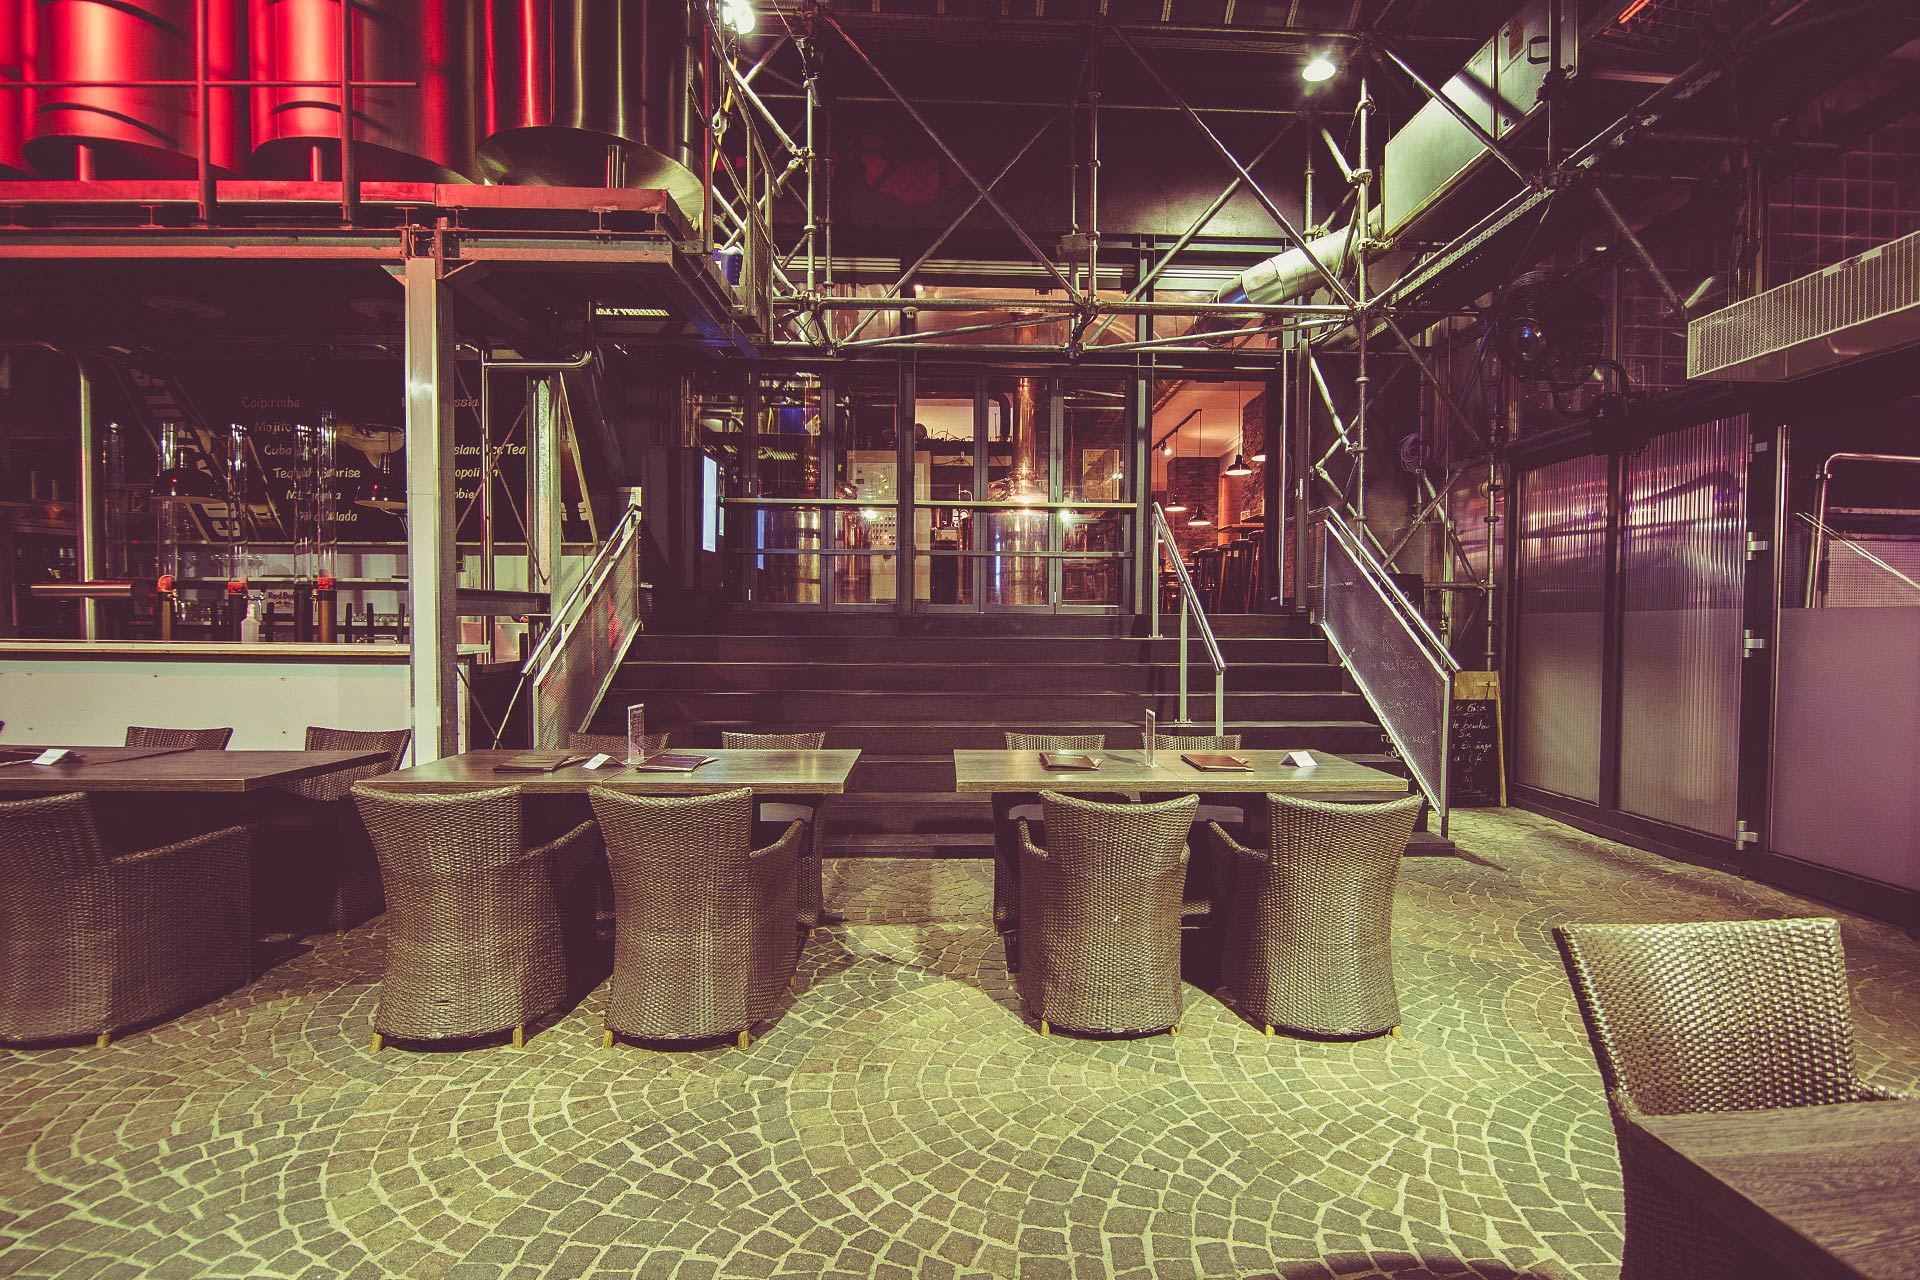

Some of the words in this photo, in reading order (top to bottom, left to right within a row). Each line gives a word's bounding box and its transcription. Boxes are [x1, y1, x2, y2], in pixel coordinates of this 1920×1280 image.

[255, 422, 292, 434] Mojito
[264, 444, 292, 456] Cuba
[506, 444, 527, 455] Tea
